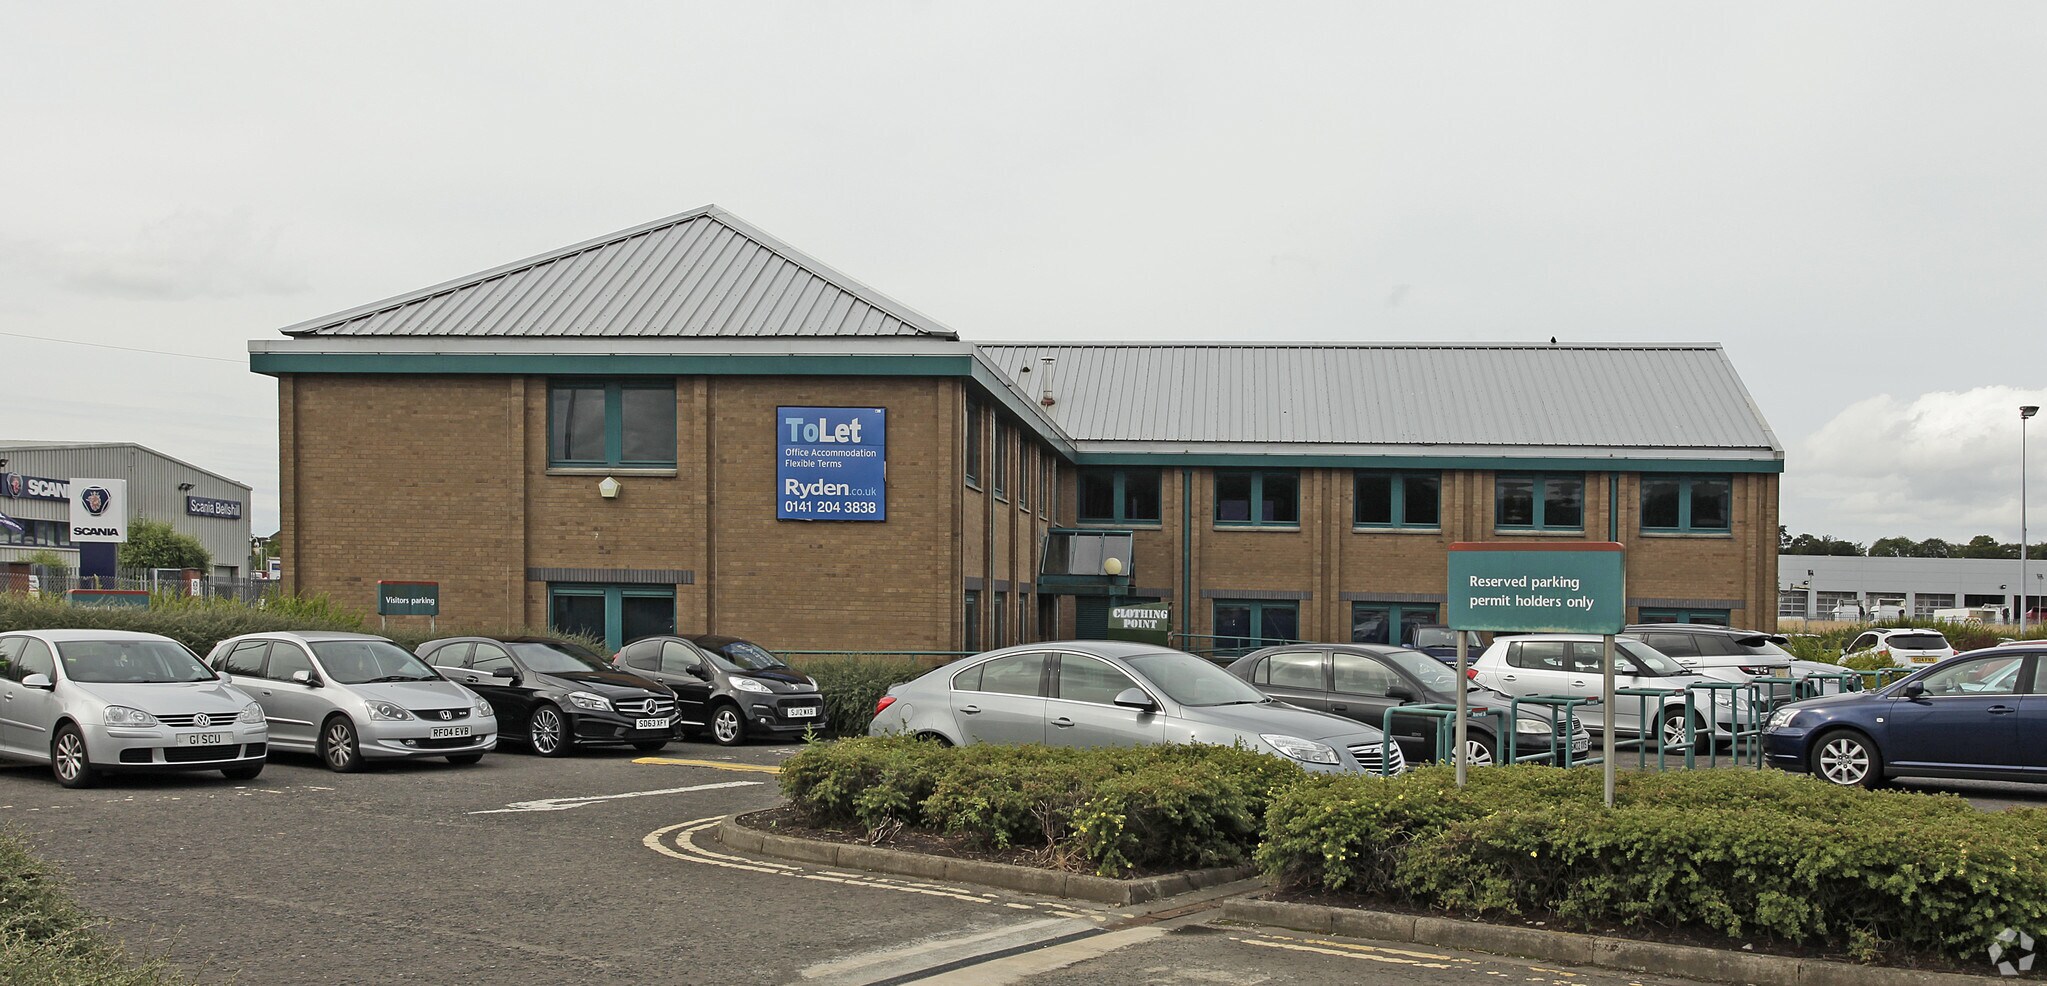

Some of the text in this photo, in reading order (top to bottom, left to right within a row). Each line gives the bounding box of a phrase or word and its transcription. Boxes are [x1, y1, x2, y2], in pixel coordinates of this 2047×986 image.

[785, 448, 877, 458] Office Accommodation
[785, 459, 842, 468] Flexible Terms
[191, 499, 241, 517] Scania Bellshill
[785, 501, 876, 514] 0141 204 3838
[73, 527, 119, 536] SCANIA
[1469, 575, 1580, 591] Reserved parking
[385, 596, 435, 606] Visitors parking
[1469, 594, 1595, 612] permit holders only
[1113, 608, 1168, 619] CLOTHING
[1123, 619, 1158, 629] POINT
[638, 719, 656, 728] SO63
[433, 727, 469, 738] RF04 EVB
[201, 734, 221, 744] SCU
